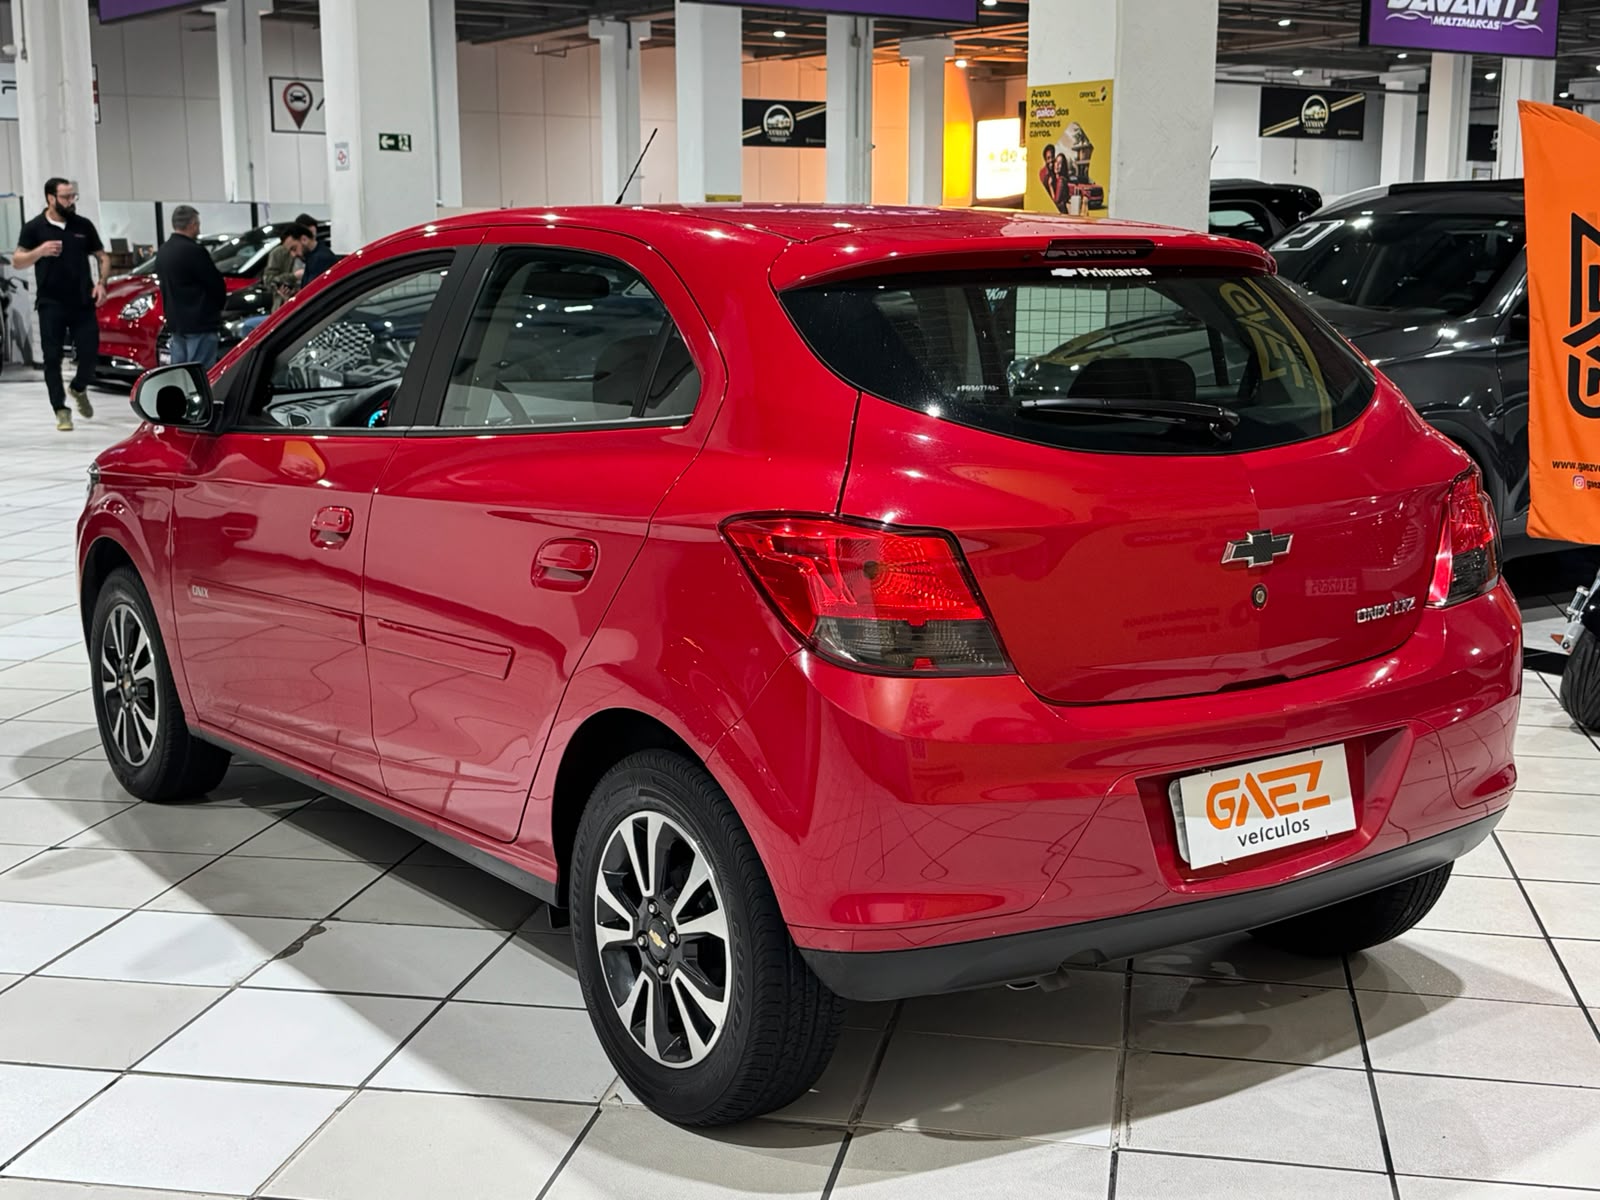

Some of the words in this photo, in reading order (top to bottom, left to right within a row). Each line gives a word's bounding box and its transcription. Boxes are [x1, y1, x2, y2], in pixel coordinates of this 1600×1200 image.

[1433, 16, 1500, 30] MULTIMARCAS
[1031, 89, 1051, 98] Arena
[1056, 108, 1069, 116] dos
[1029, 119, 1061, 128] melhores
[1077, 267, 1152, 277] Primarca
[192, 585, 208, 598] ONIX
[1357, 603, 1391, 623] ONIX
[1394, 597, 1416, 615] LTZ
[1206, 760, 1331, 830] GAEZ
[1237, 817, 1310, 848] veículos
